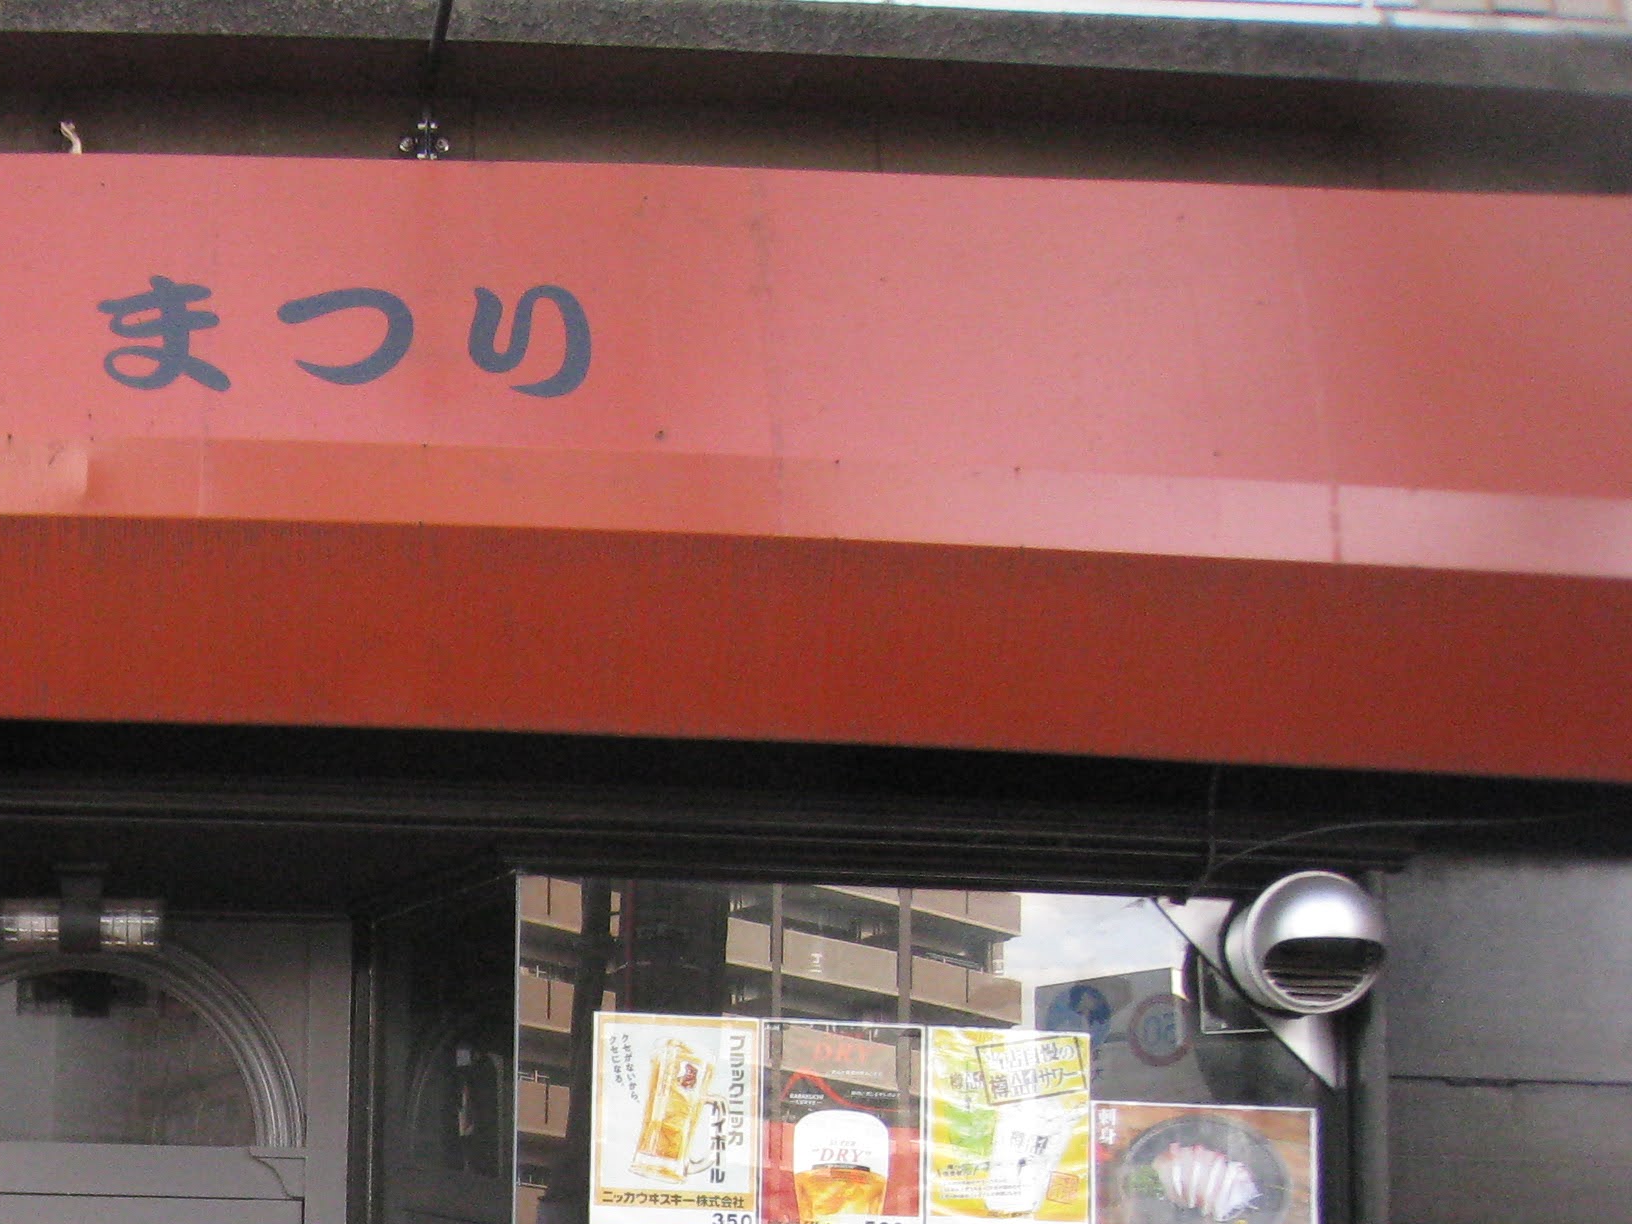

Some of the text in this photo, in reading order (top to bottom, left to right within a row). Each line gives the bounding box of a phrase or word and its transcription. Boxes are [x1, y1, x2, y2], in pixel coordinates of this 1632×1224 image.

[98, 275, 593, 398] まつり
[728, 1035, 745, 1146] ブラックニッカ
[1098, 1108, 1117, 1145] 刺身
[709, 1101, 726, 1184] ハイボール
[602, 1191, 744, 1209] ニッカウヰスキー株式会社
